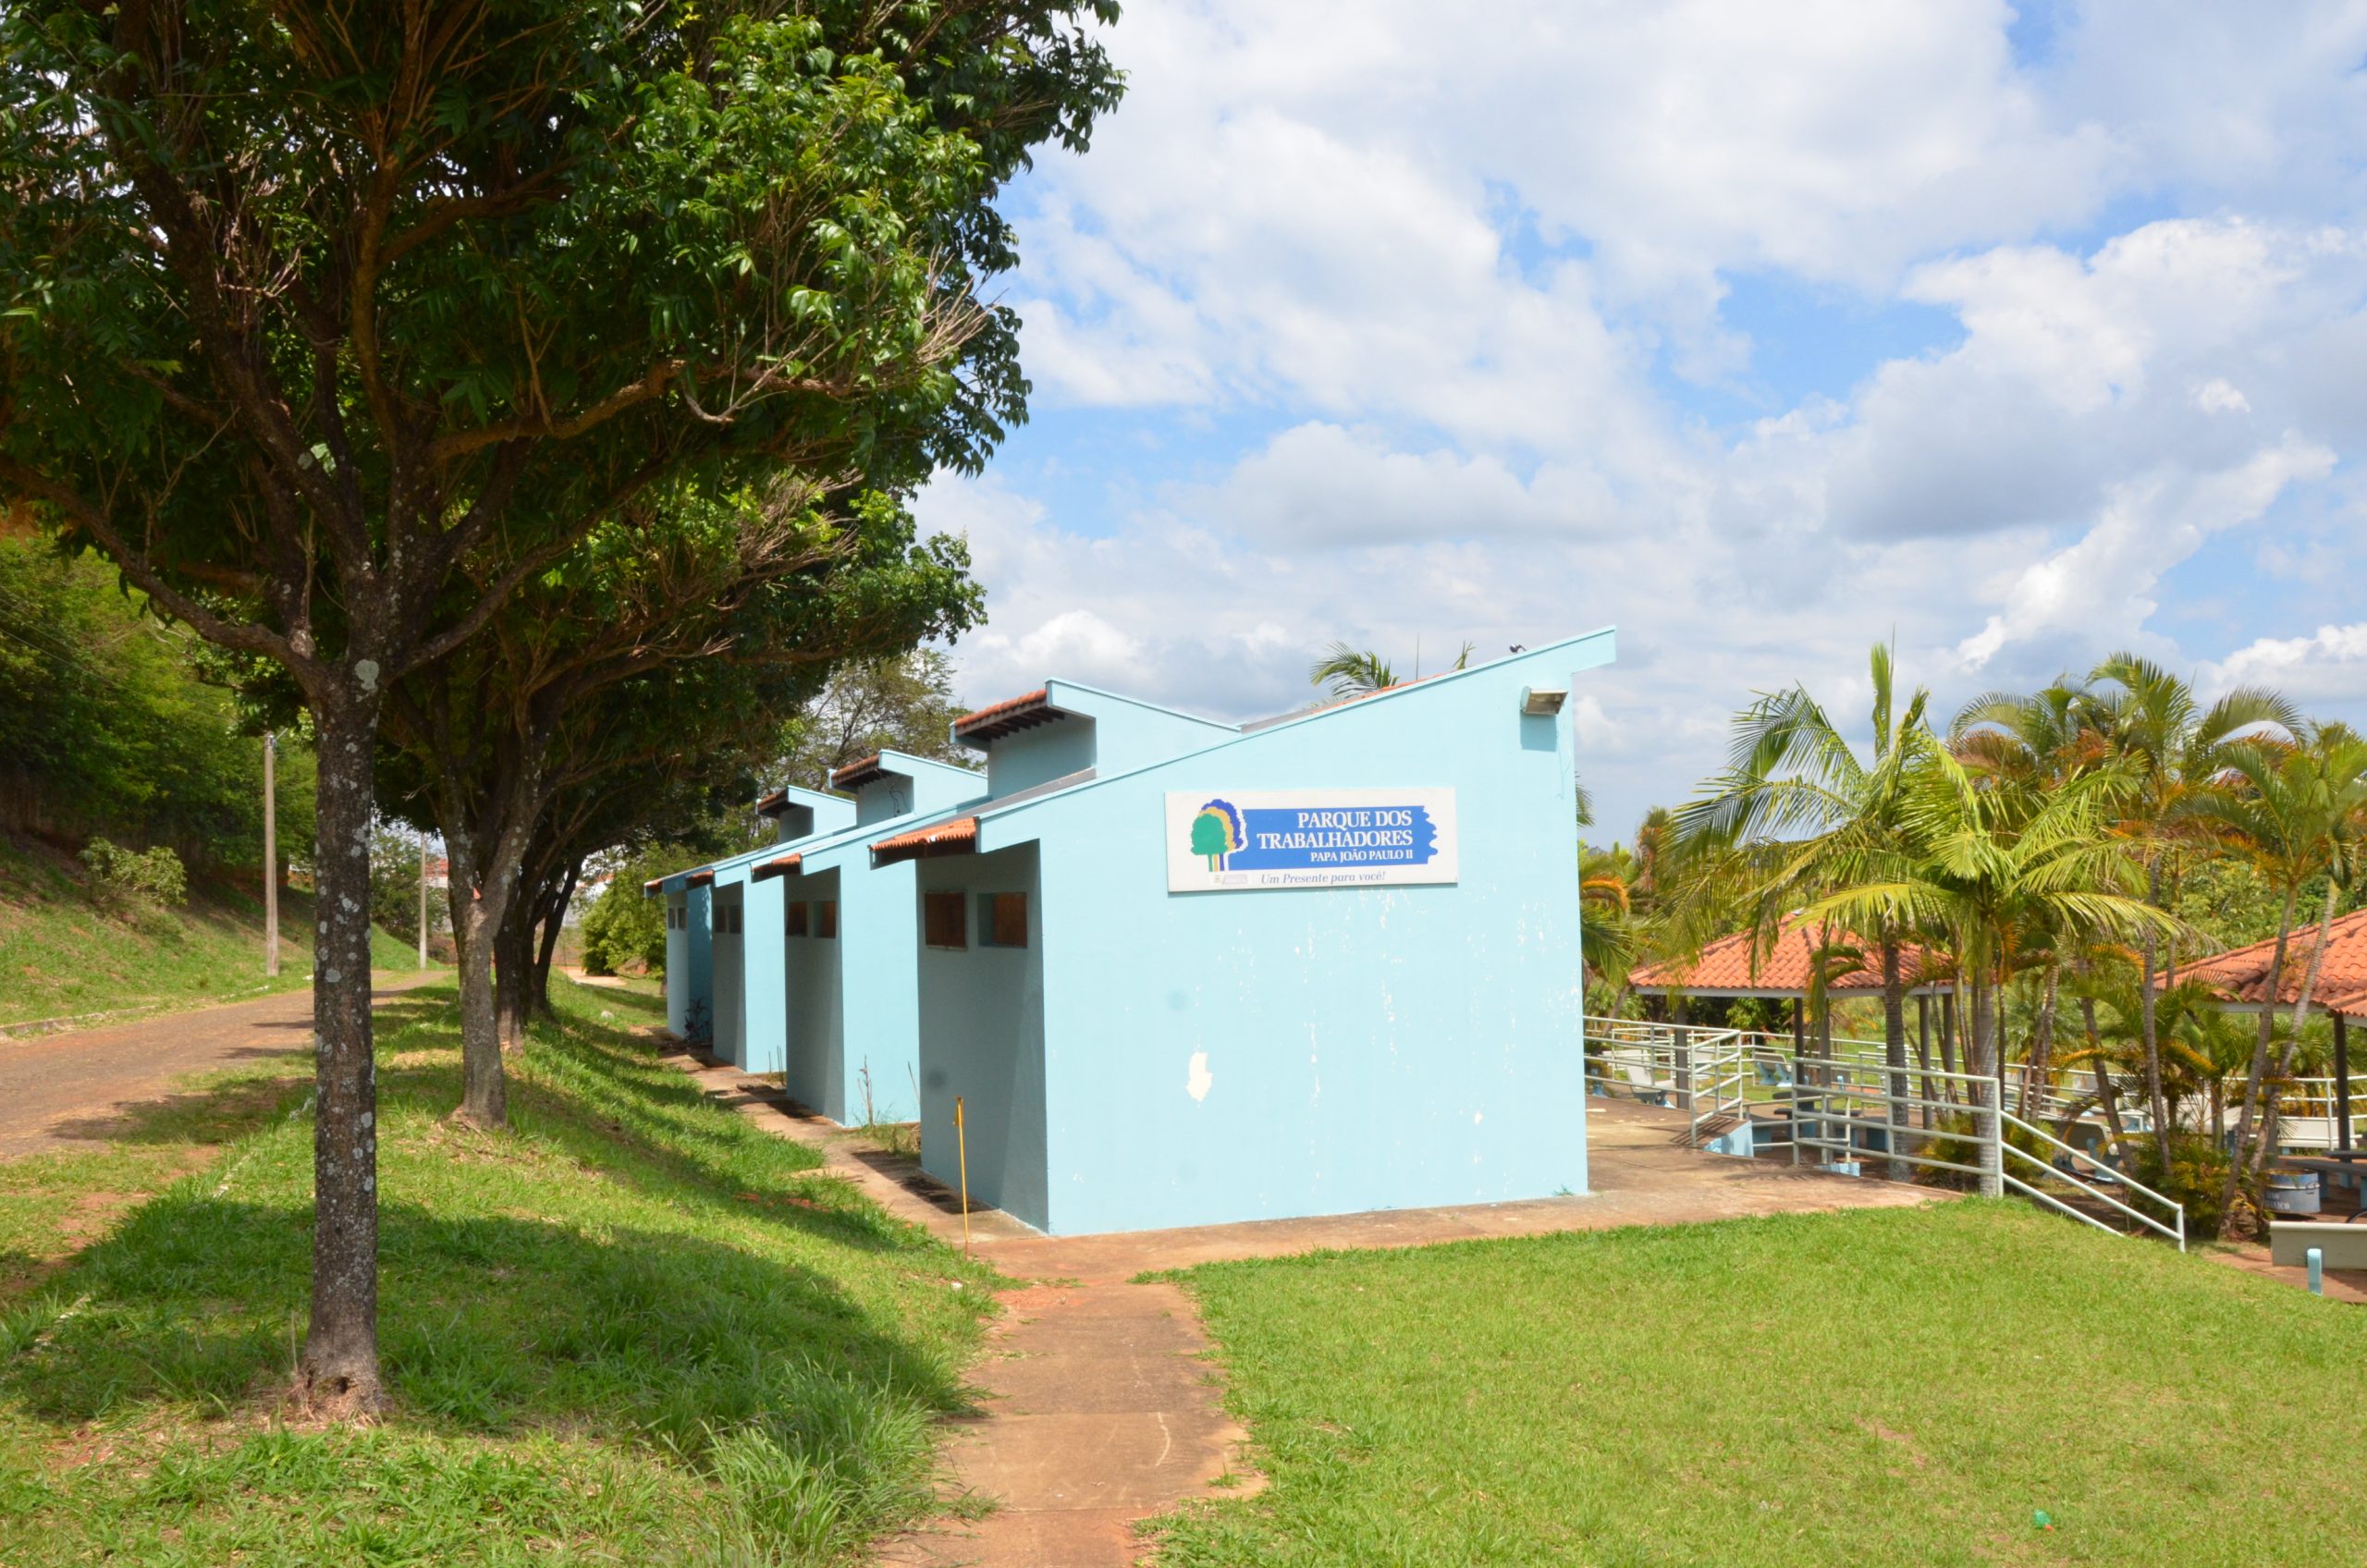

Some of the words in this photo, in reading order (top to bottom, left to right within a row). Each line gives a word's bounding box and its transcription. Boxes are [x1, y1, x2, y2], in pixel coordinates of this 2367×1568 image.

[1298, 811, 1371, 830] PARQUE
[1375, 810, 1413, 827] DOS
[1257, 829, 1414, 850] TRABALHADORES
[1310, 851, 1338, 863] PAPA
[1340, 849, 1367, 863] JOÃO
[1368, 851, 1404, 861] PAULO
[1405, 850, 1414, 860] II
[1261, 874, 1280, 885] Um
[1282, 872, 1328, 884] Presente
[1331, 875, 1355, 885] para
[1358, 871, 1386, 881] você!
